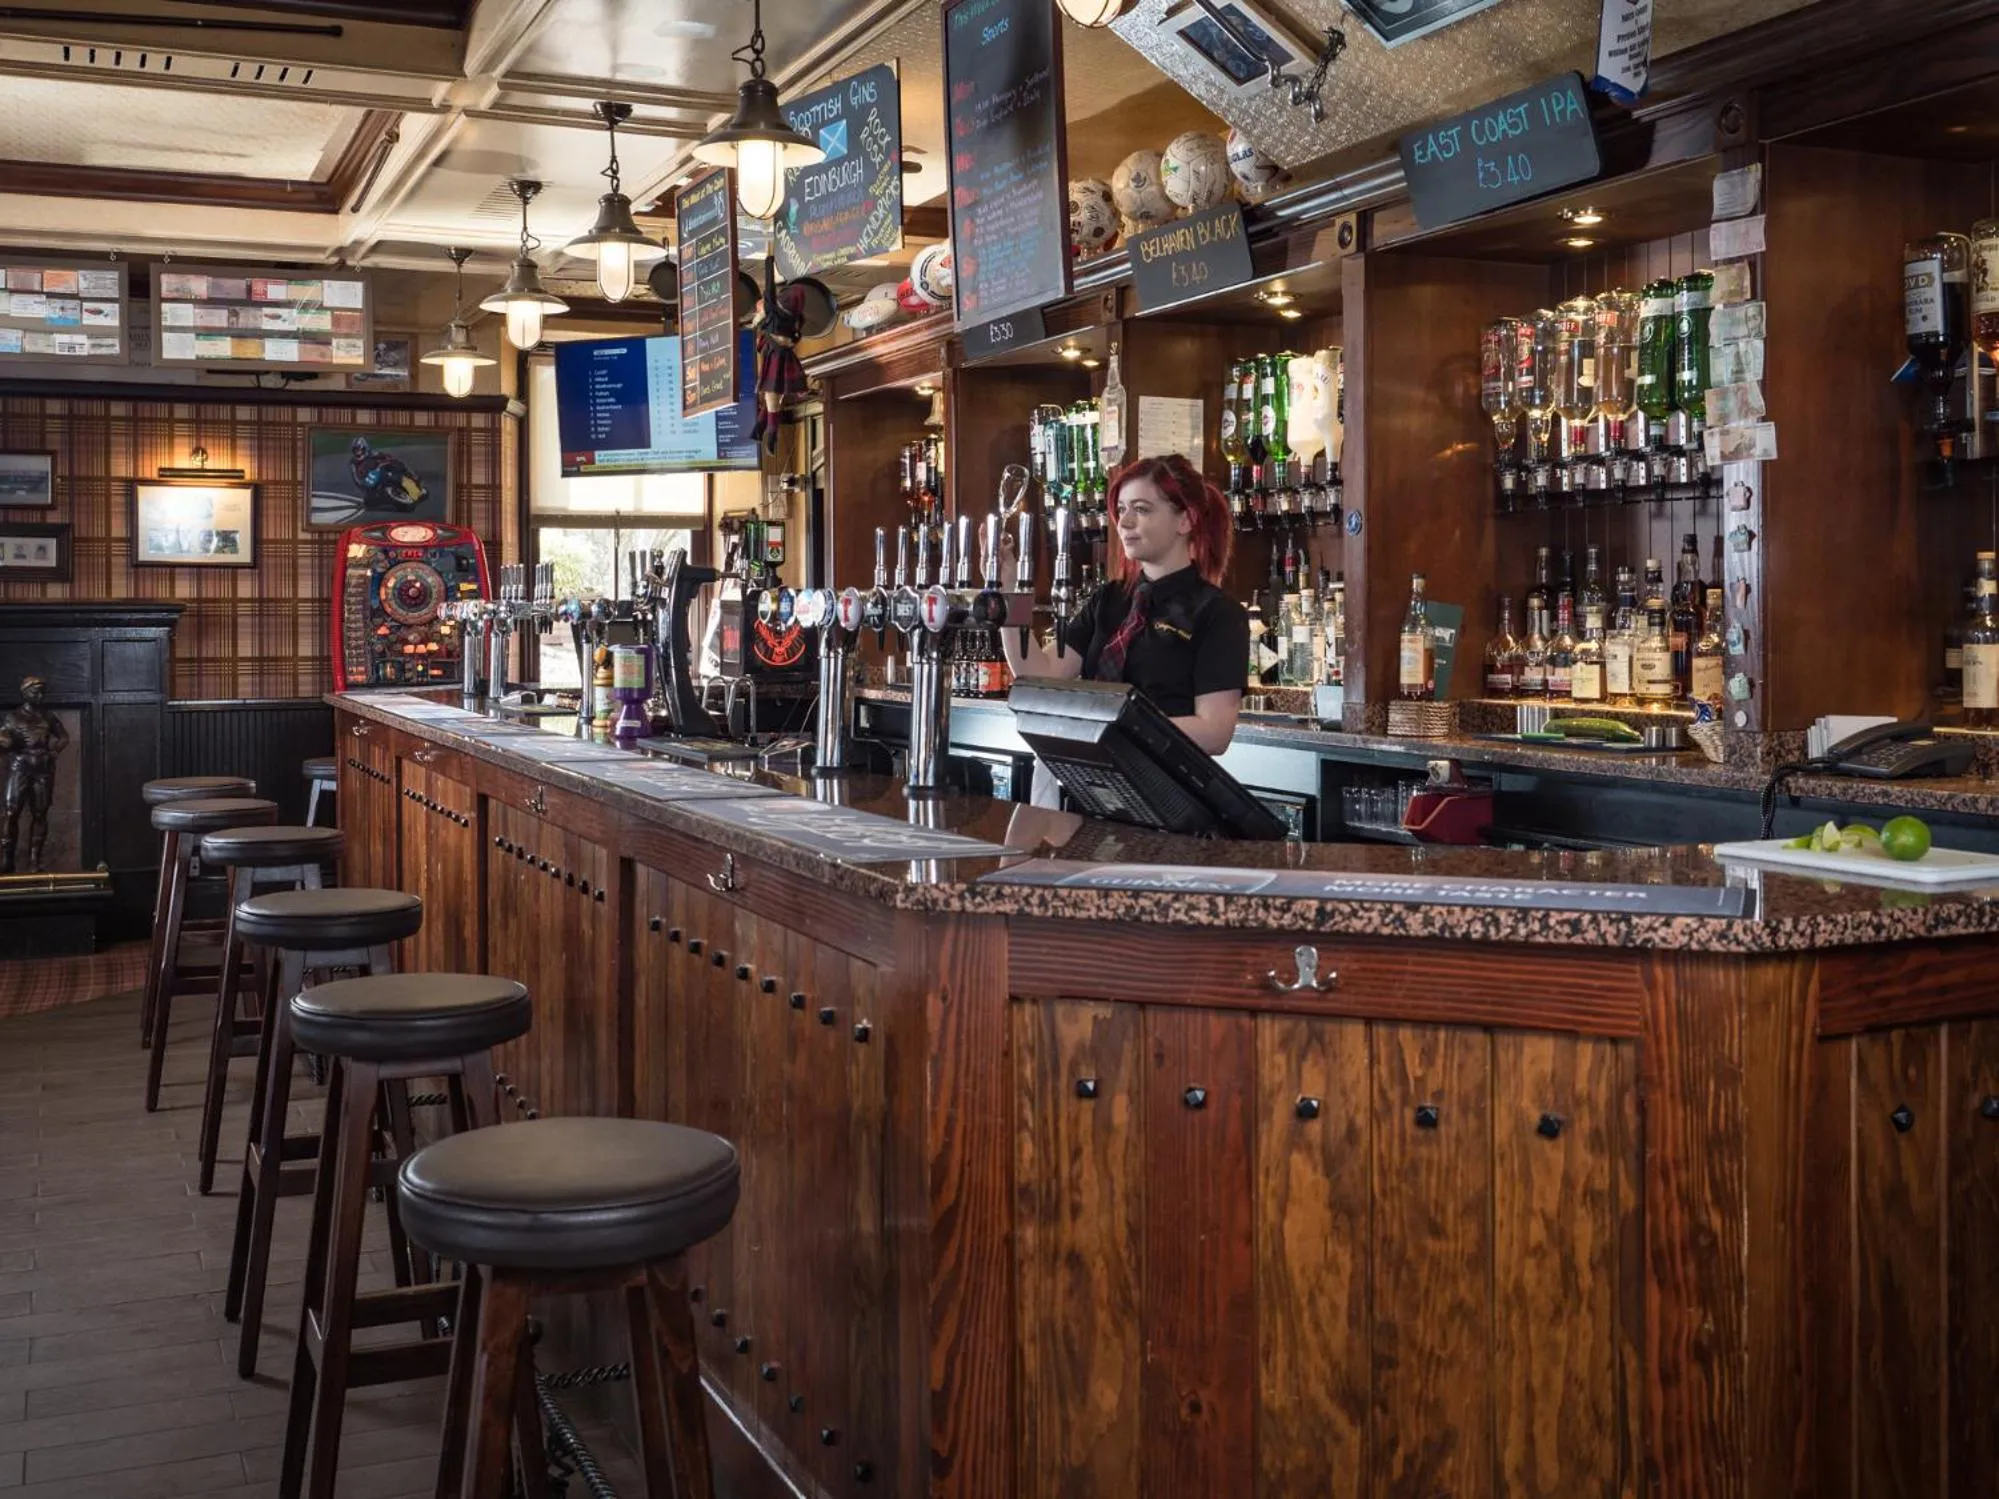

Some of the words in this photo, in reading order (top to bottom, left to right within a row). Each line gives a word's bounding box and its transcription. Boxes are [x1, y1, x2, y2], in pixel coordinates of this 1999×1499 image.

[789, 93, 842, 132] SCOTTISH
[849, 80, 879, 110] GINS
[1413, 126, 1462, 165] EAST
[1470, 102, 1530, 146] COAST
[1540, 88, 1584, 126] IPA
[804, 156, 864, 203] EDINBURGH
[1140, 226, 1196, 263] BELHAVEN
[1196, 211, 1238, 245] BLACK
